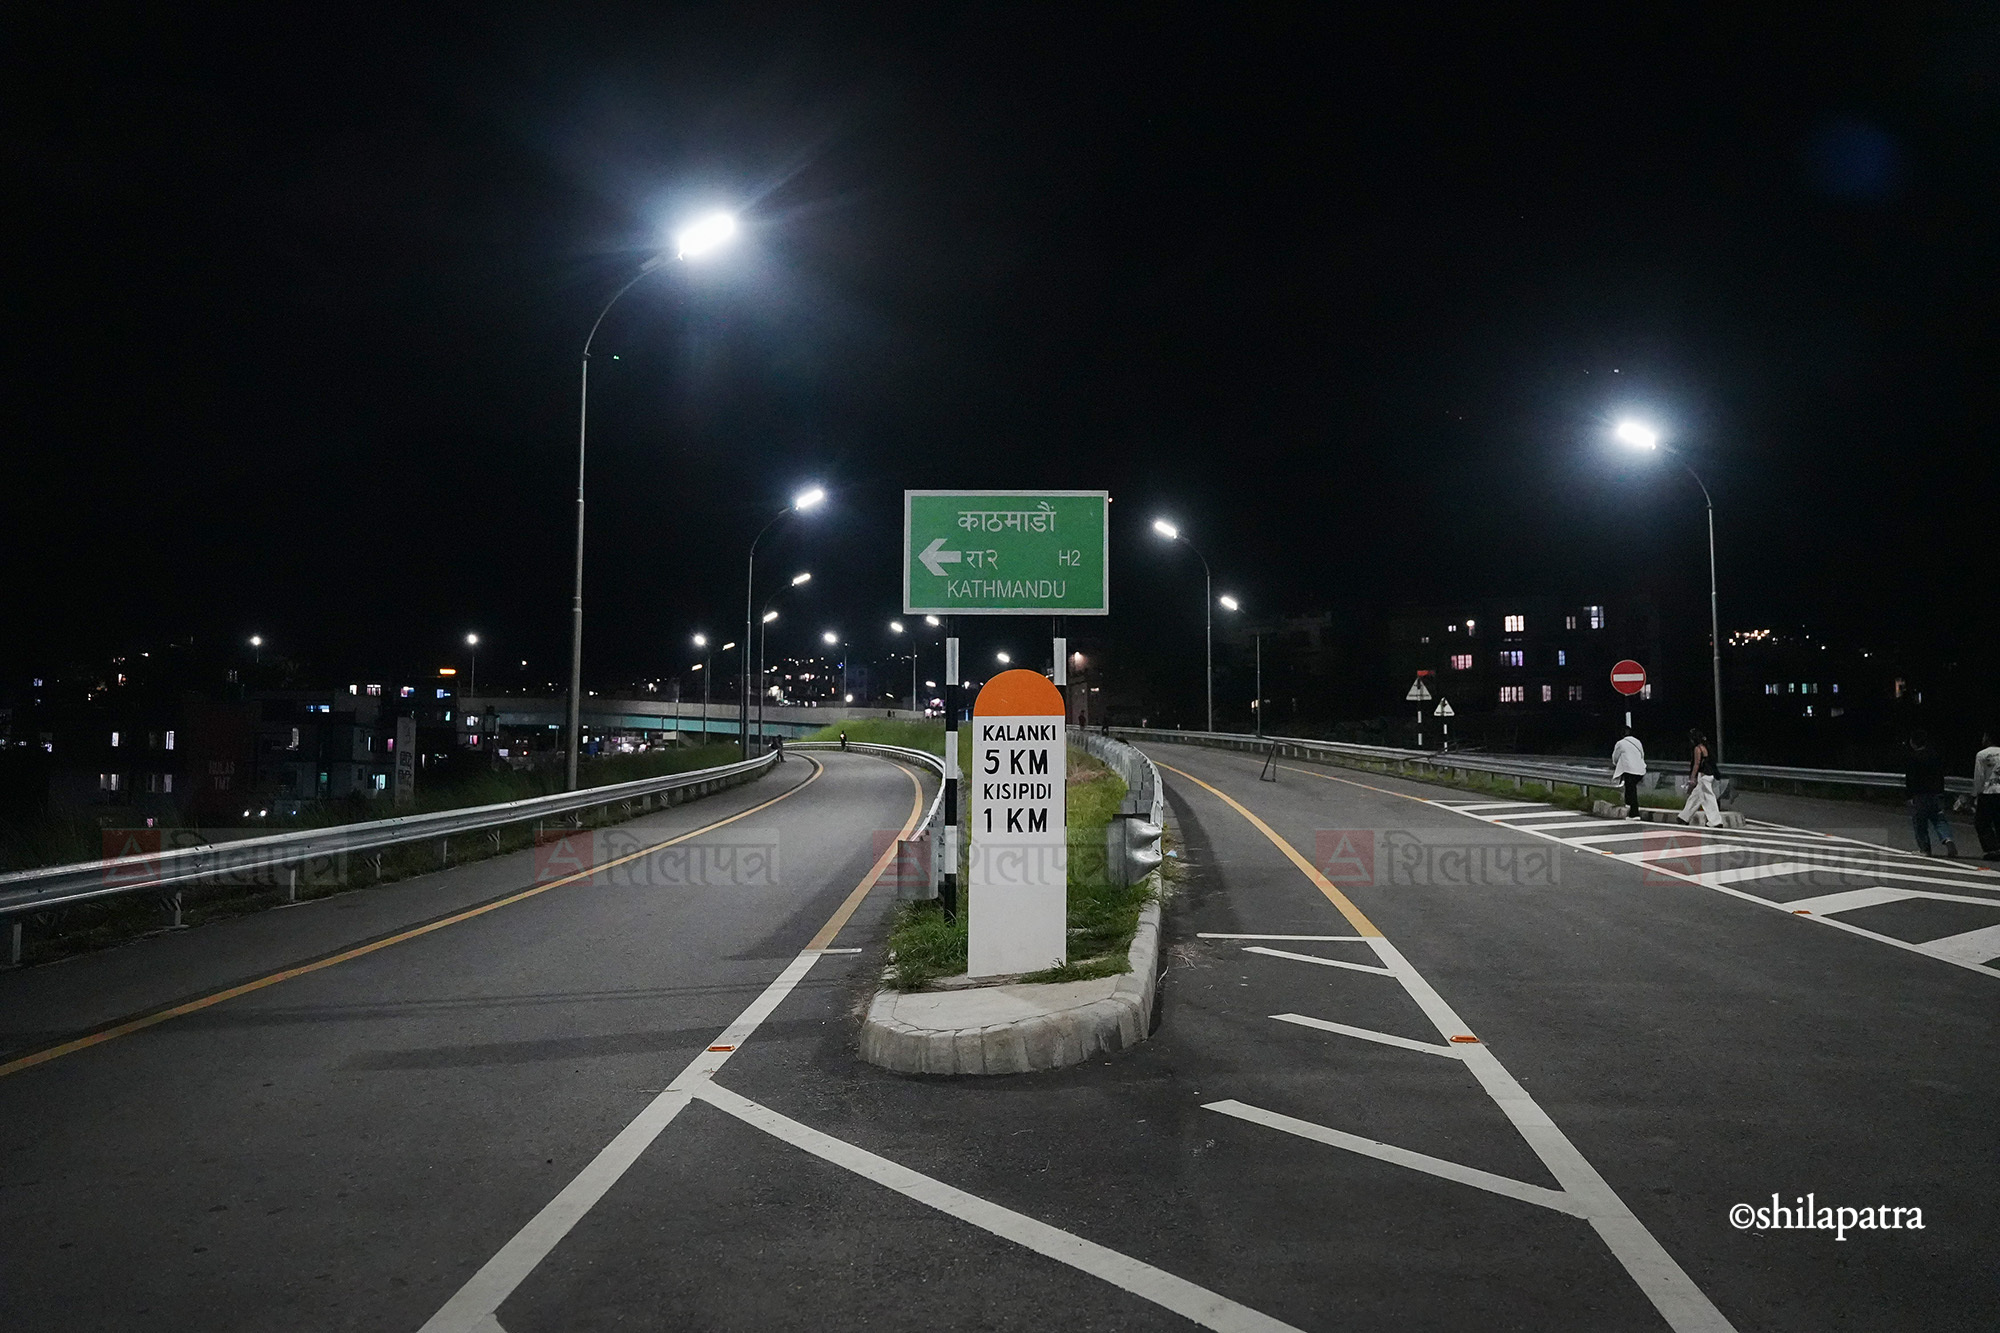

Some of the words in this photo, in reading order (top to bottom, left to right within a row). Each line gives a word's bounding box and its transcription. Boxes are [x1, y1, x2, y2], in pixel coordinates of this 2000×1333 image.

[957, 500, 1057, 533] काठमाडौं
[1058, 549, 1081, 567] H2
[947, 579, 1066, 599] KATHMANDU
[983, 724, 1057, 742] KALANKI
[984, 749, 1000, 775] 5
[1010, 749, 1048, 775] KM
[984, 783, 1052, 800] KISIPIDI
[984, 807, 993, 833] 1
[1007, 807, 1048, 833] KM
